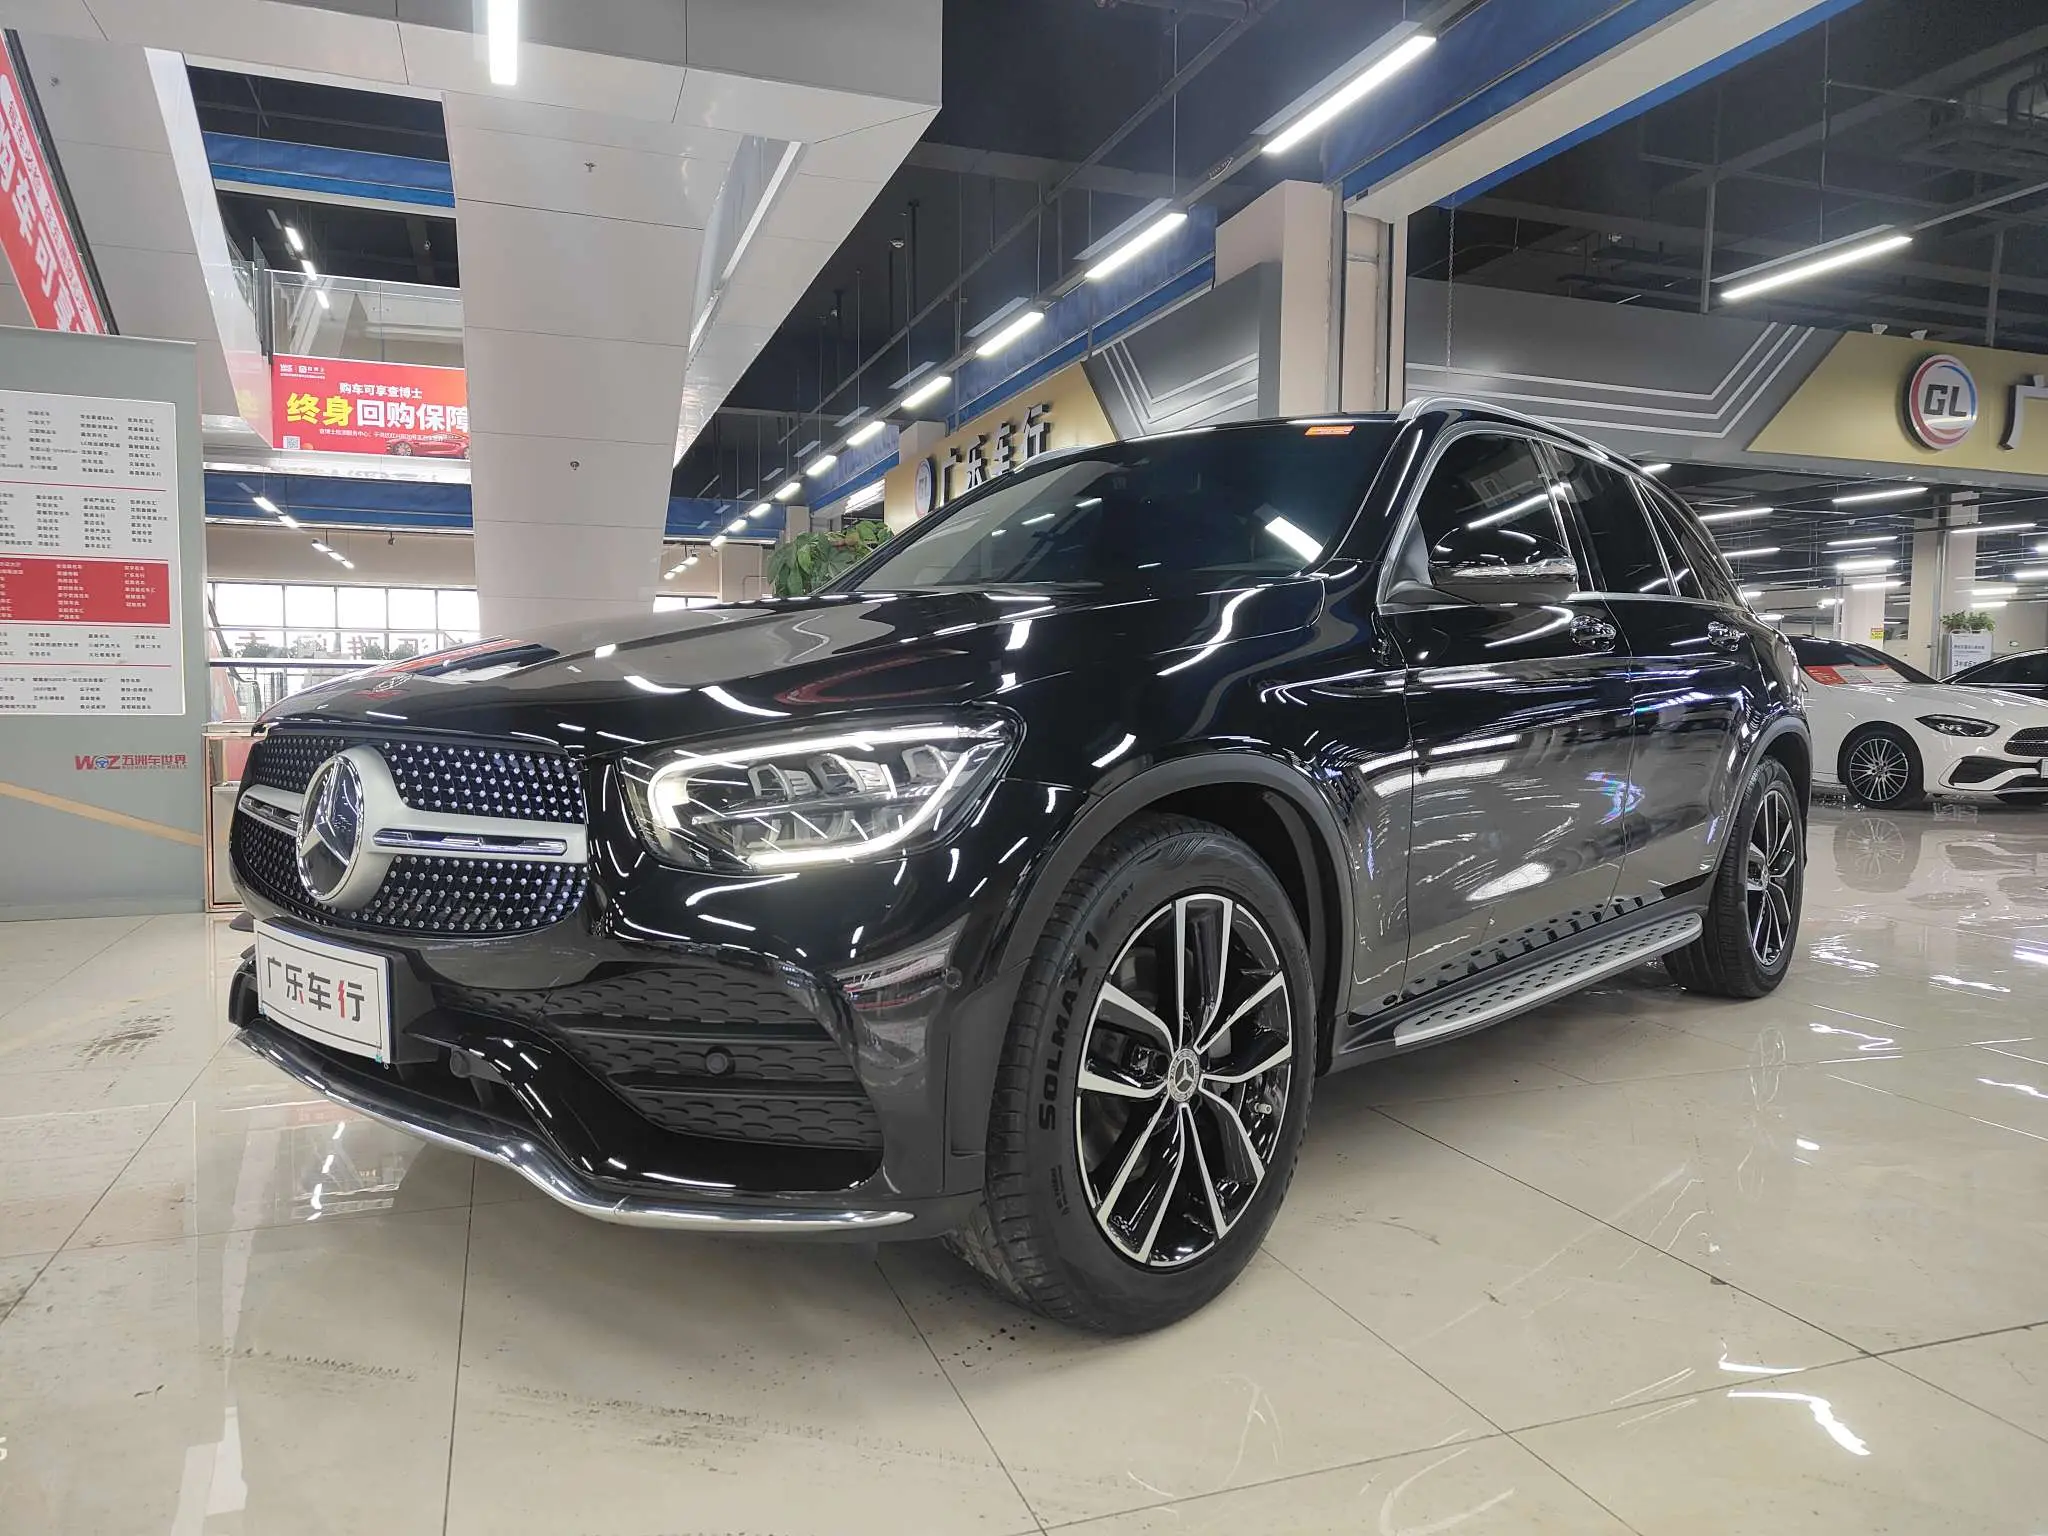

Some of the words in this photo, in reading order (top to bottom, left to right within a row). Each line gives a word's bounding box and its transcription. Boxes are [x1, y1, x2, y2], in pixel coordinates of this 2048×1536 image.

[339, 382, 422, 399] 购车可享查博士
[1923, 383, 1967, 417] GL
[286, 392, 470, 433] 终身回购保障
[122, 754, 188, 766] 五洲车世界
[1039, 958, 1088, 1131] SOLMAX
